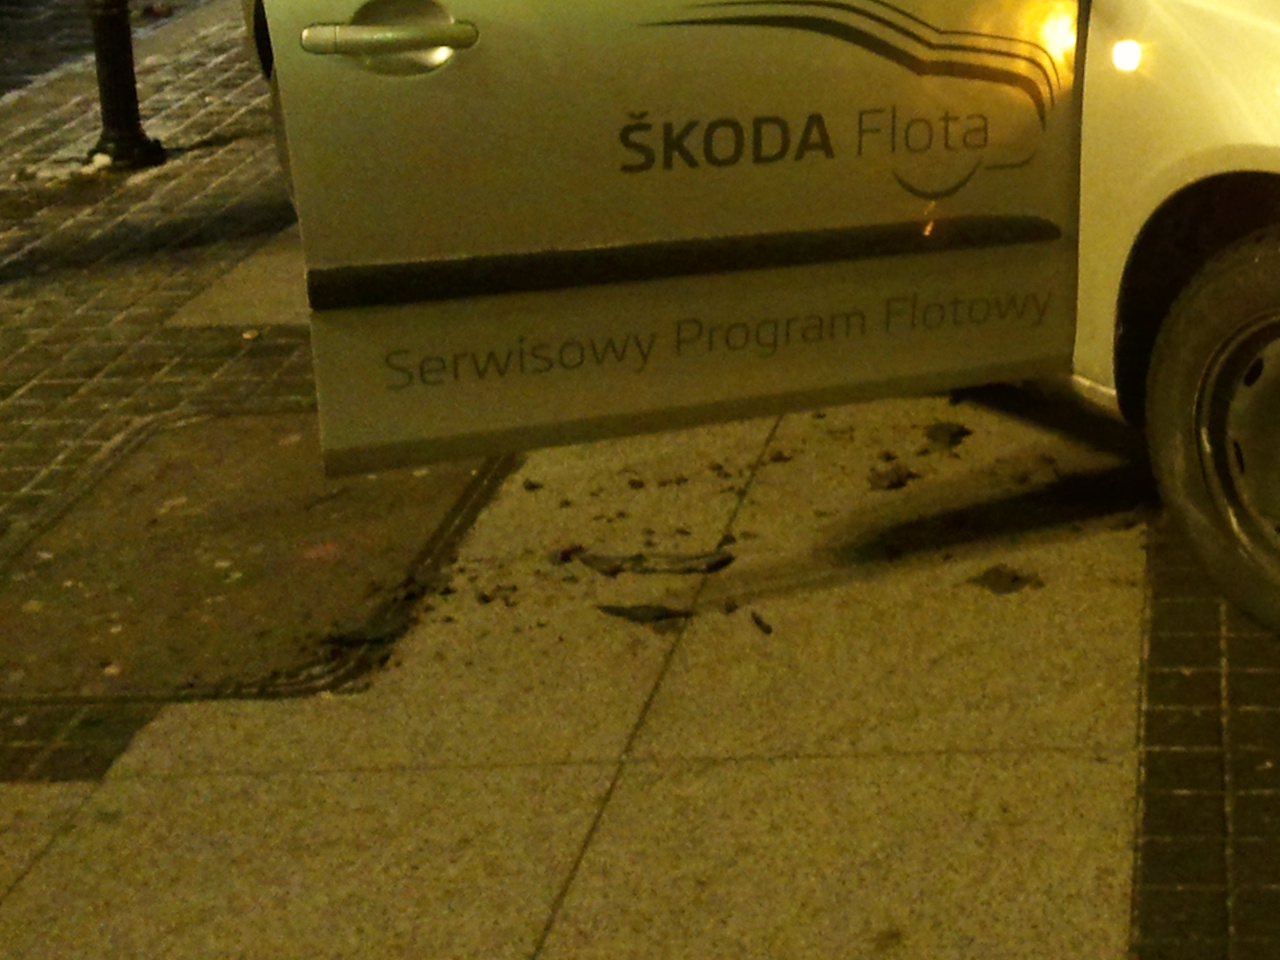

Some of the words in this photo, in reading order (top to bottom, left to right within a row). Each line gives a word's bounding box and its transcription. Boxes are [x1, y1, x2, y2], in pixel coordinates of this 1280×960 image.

[619, 111, 834, 173] ŠKODA
[857, 105, 989, 156] Flota
[383, 329, 657, 391] Serwisowy
[674, 308, 868, 359] Program
[884, 287, 1054, 334] Flotowy
